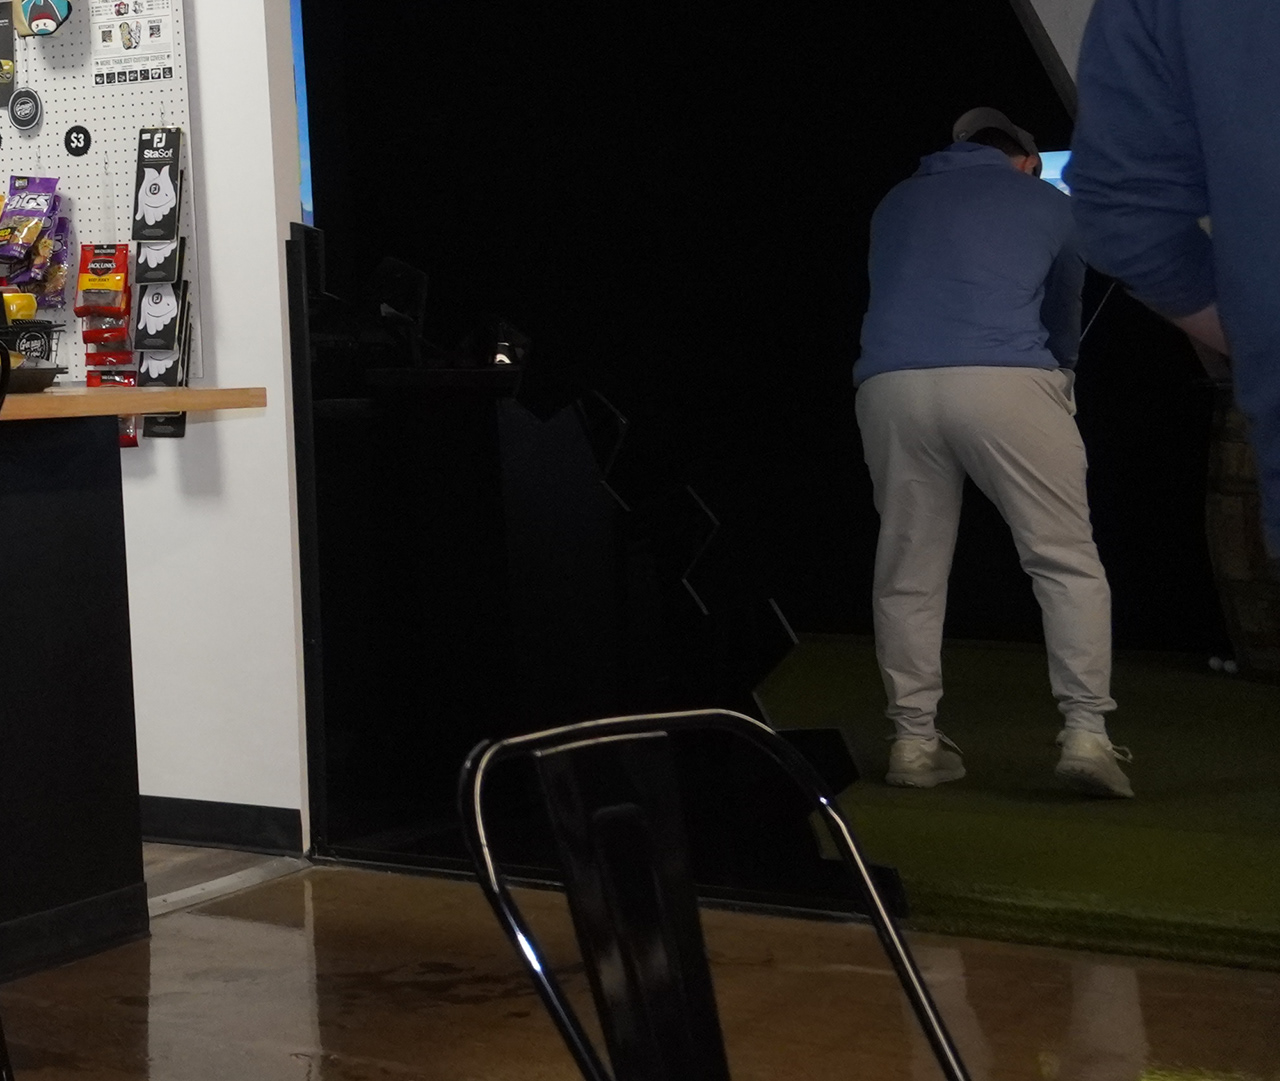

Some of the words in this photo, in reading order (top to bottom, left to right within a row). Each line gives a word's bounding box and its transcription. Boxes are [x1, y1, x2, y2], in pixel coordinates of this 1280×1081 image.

[71, 132, 84, 148] $3
[153, 133, 166, 147] FJ
[143, 149, 173, 158] StaSof
